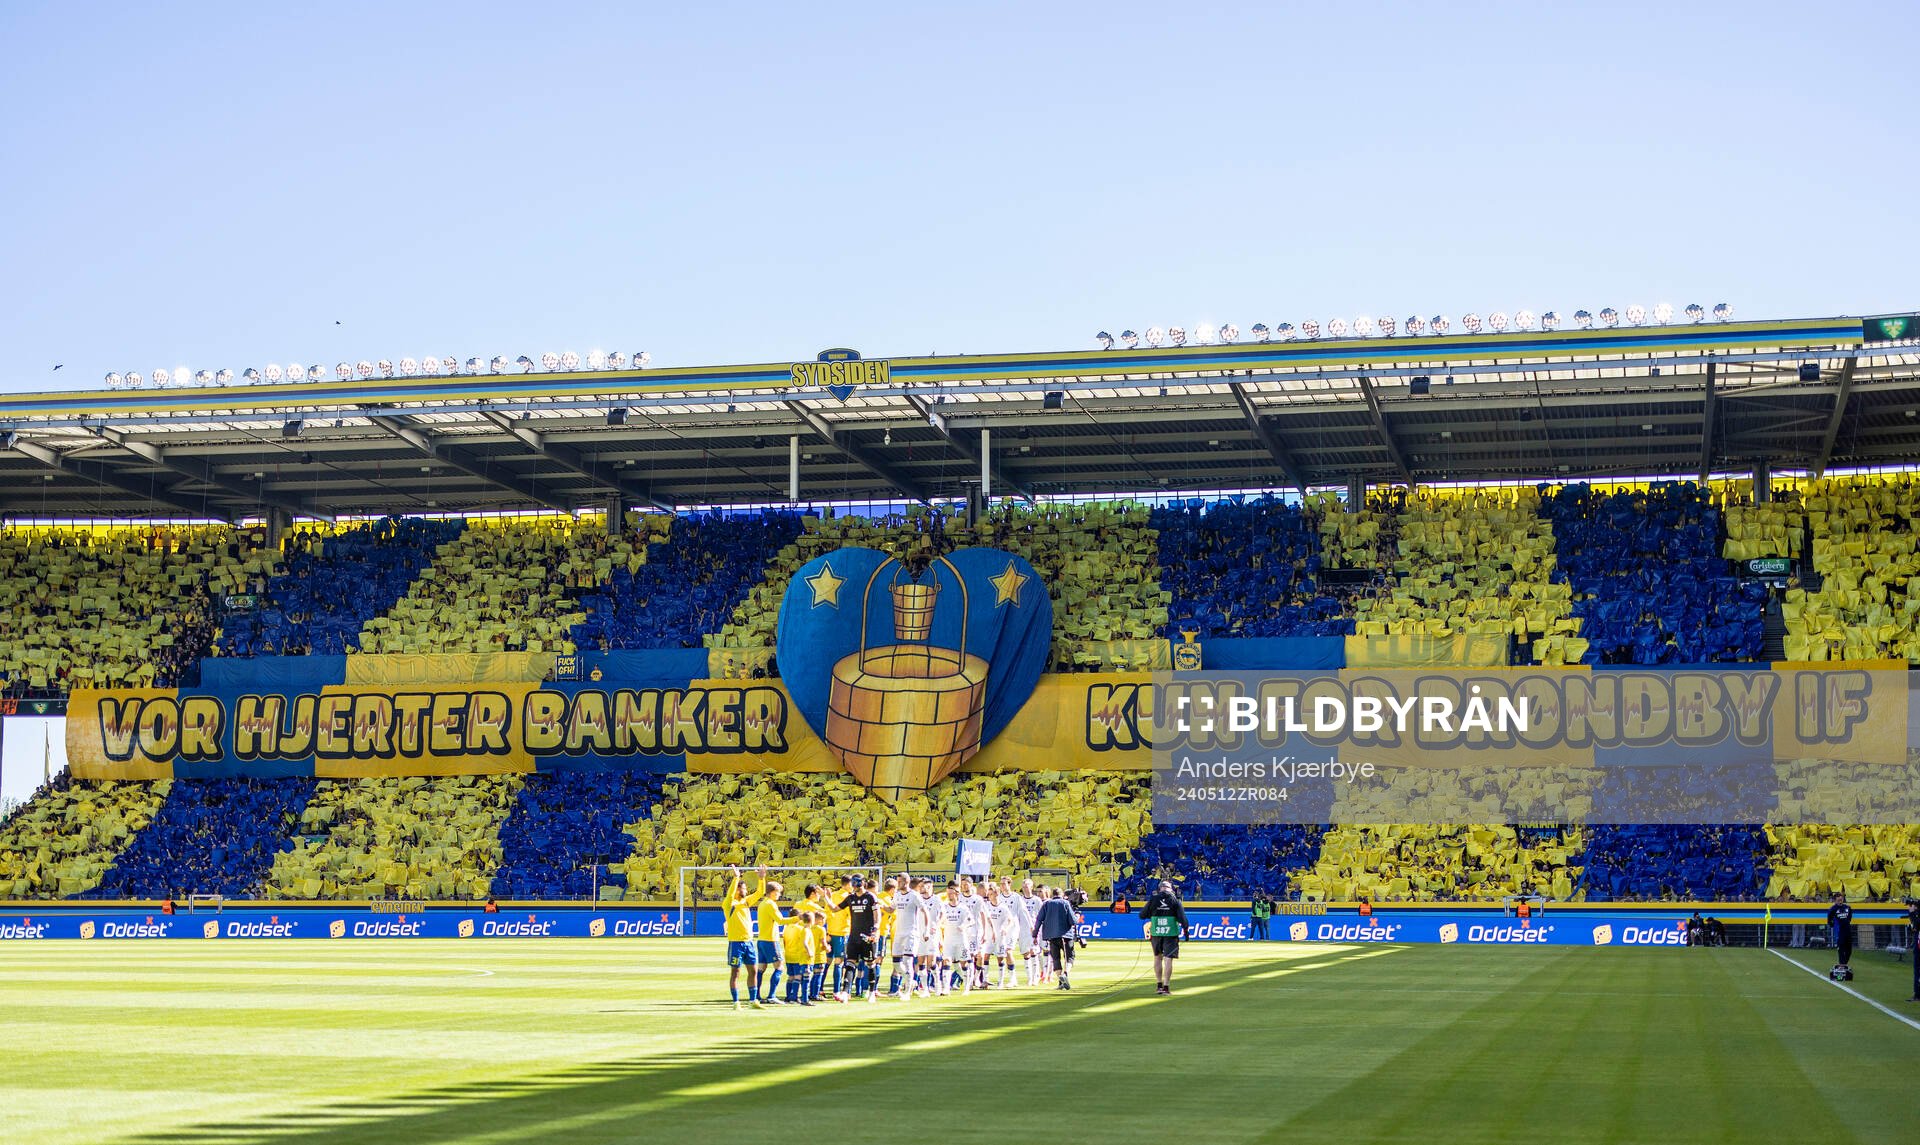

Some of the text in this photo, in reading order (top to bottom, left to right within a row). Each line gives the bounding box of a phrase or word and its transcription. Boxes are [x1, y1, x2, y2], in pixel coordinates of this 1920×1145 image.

[791, 361, 889, 387] SYDSIDEN
[1750, 560, 1785, 573] Carlsberg
[558, 657, 576, 666] FUCK
[558, 666, 575, 675] GFH!
[98, 696, 226, 762] VOR
[234, 691, 512, 760] HJERTER
[522, 686, 788, 757] BANKER
[1086, 680, 1245, 751] KUN
[1256, 676, 1402, 748] FOR
[1795, 670, 1873, 744] IF
[1277, 904, 1327, 915] DSIDEN
[0, 923, 44, 939] ddset
[103, 922, 167, 938] Oddset
[227, 922, 293, 937] Oddset
[353, 921, 420, 936] Oddset
[482, 921, 550, 936] Oddset
[1155, 926, 1171, 934] 387
[1317, 924, 1396, 941] Oddset
[1468, 925, 1548, 942] Oddset
